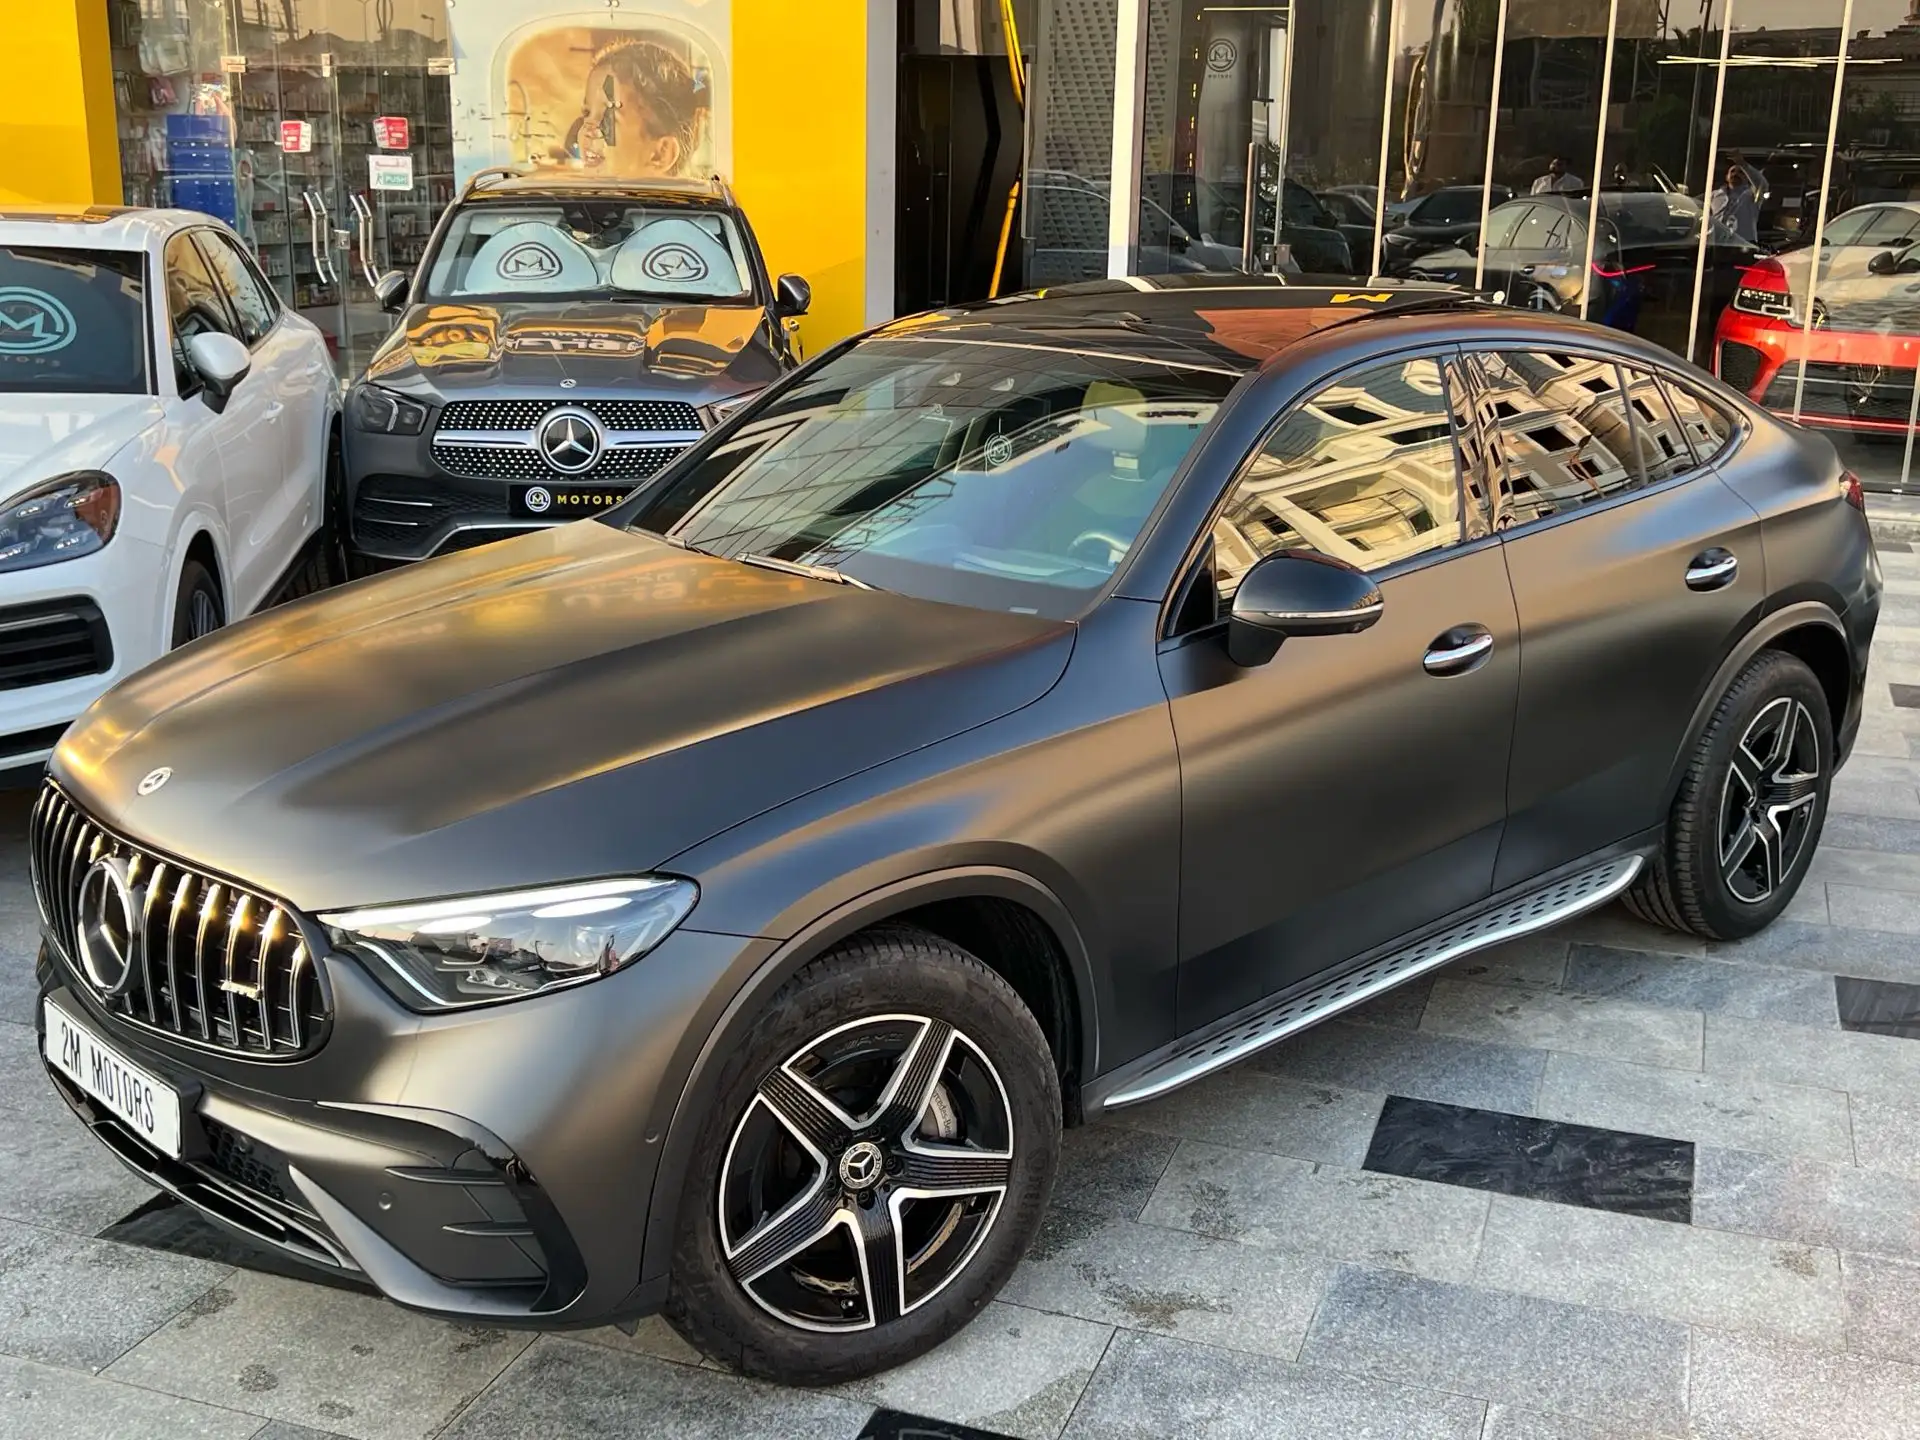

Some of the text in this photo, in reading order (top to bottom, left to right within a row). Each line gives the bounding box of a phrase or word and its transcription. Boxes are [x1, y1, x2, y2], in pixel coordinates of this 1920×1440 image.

[1, 354, 61, 368] TORS
[557, 494, 625, 505] MOTORS
[61, 1021, 154, 1134] 2M MOTORS
